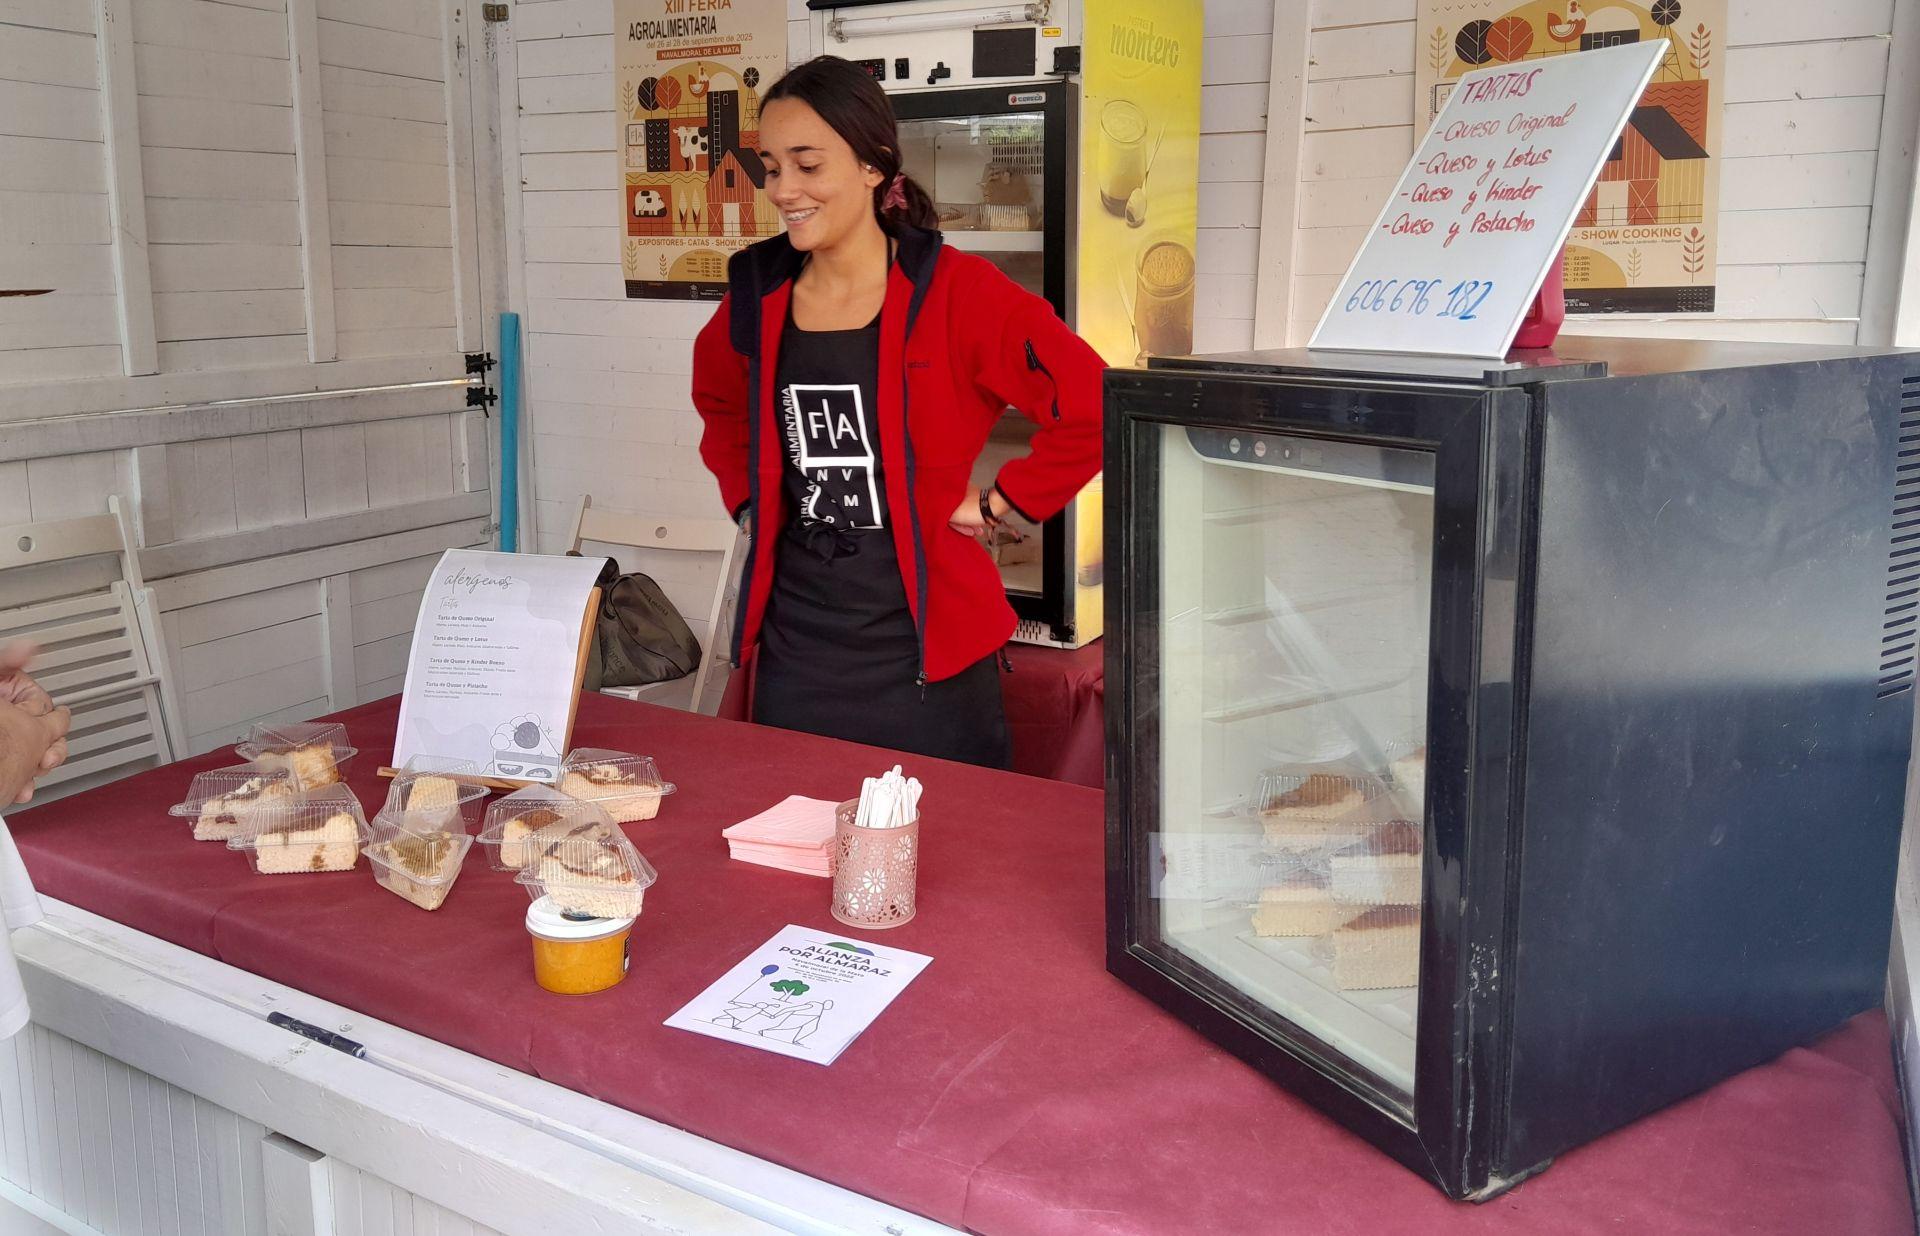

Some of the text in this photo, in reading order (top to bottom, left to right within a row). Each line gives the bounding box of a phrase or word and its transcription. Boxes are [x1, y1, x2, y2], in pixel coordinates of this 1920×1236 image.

[666, 0, 732, 14] XIII FERIA
[629, 16, 717, 41] AGROALIMENTARIA
[661, 49, 701, 59] NAVALMORAL
[713, 47, 721, 55] LA
[723, 46, 739, 54] MATA
[1462, 68, 1543, 104] TARTAS
[1508, 102, 1577, 141] Original
[1477, 158, 1496, 186] y
[1503, 145, 1552, 169] Lotus
[1461, 190, 1477, 214] y
[1485, 177, 1543, 202] Kinder
[1443, 222, 1460, 248] y
[1470, 210, 1535, 233] Pistacho
[1581, 230, 1618, 240] SHOW
[1623, 228, 1682, 238] COOKING
[1437, 280, 1493, 320] 182
[779, 946, 812, 959] POR
[814, 955, 892, 977] ALMARAZ
[805, 945, 871, 965] ALIANZA
